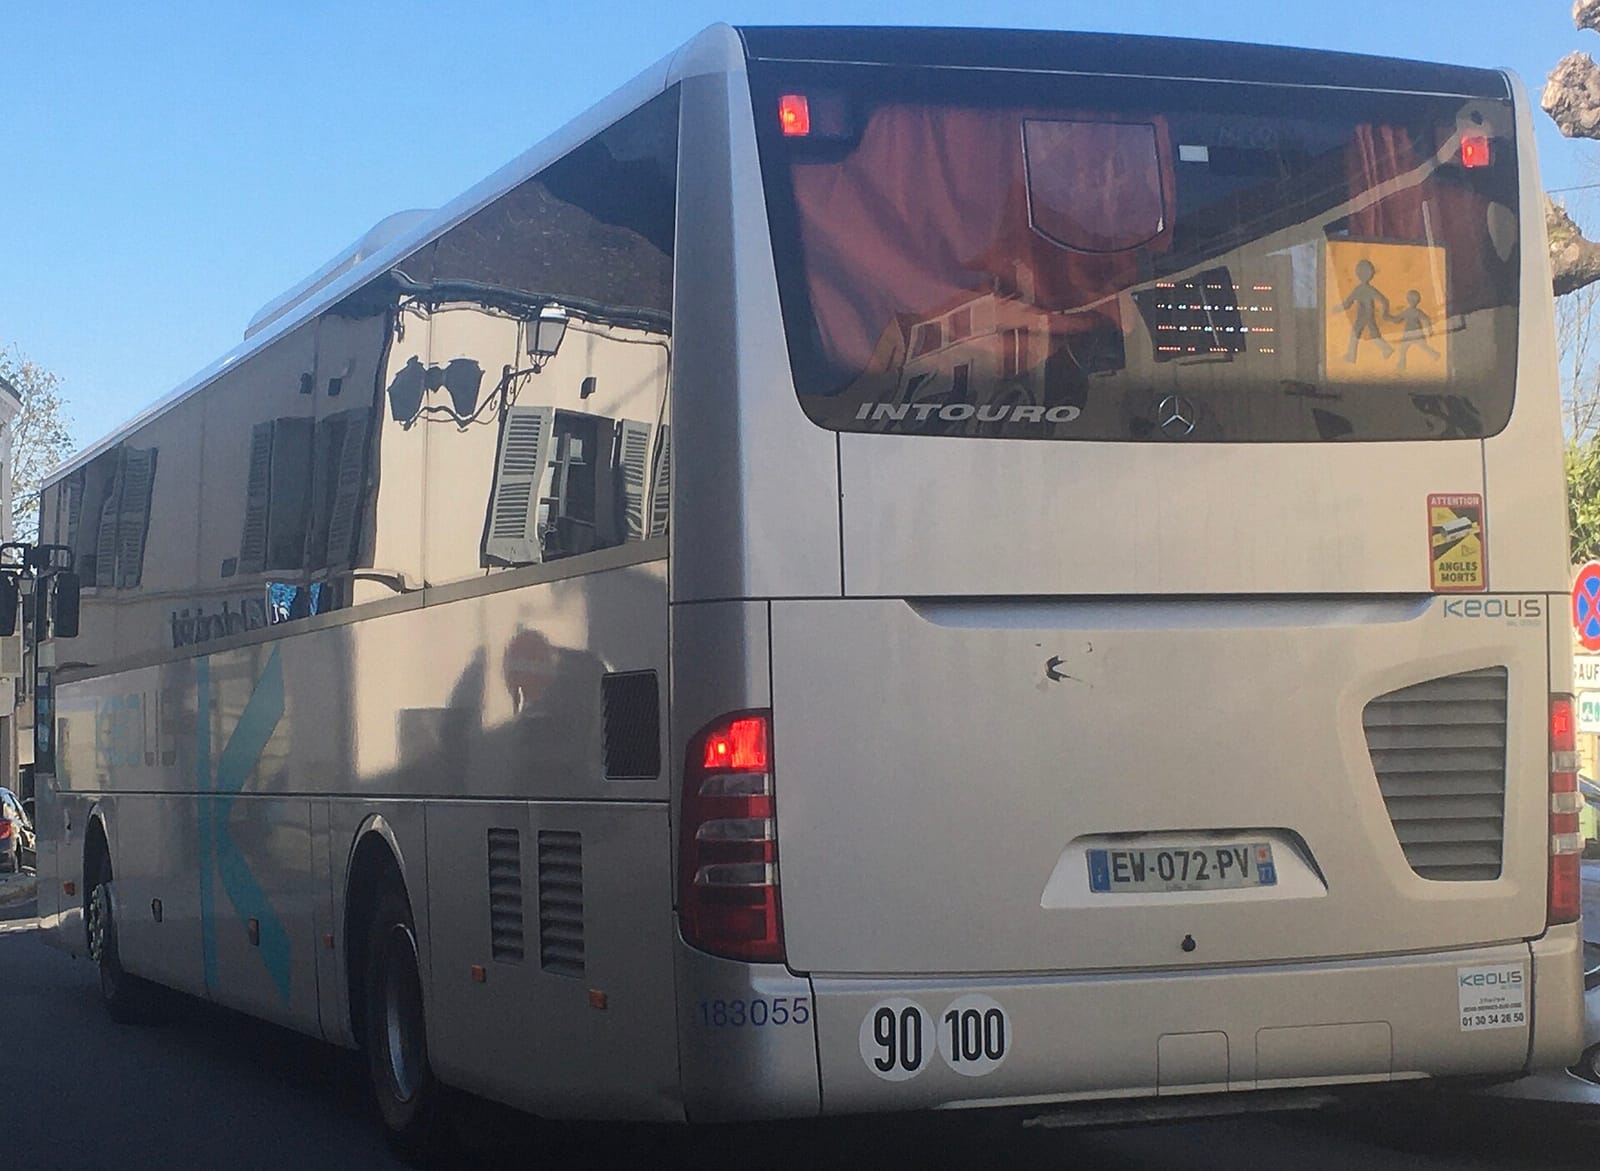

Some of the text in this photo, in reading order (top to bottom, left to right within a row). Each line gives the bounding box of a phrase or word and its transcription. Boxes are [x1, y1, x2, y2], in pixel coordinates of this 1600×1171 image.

[855, 402, 1081, 423] INTOURO
[1431, 496, 1479, 506] ATTENTION
[1439, 561, 1478, 572] ANGLES
[1440, 572, 1477, 583] MORTS
[1110, 847, 1250, 883] EW-072-PV
[700, 996, 809, 1027] 183055
[1462, 1017, 1472, 1026] 01
[1475, 1015, 1486, 1025] 30
[1488, 1014, 1498, 1024] 34
[873, 1006, 922, 1073] 90
[944, 1007, 1006, 1062] 100
